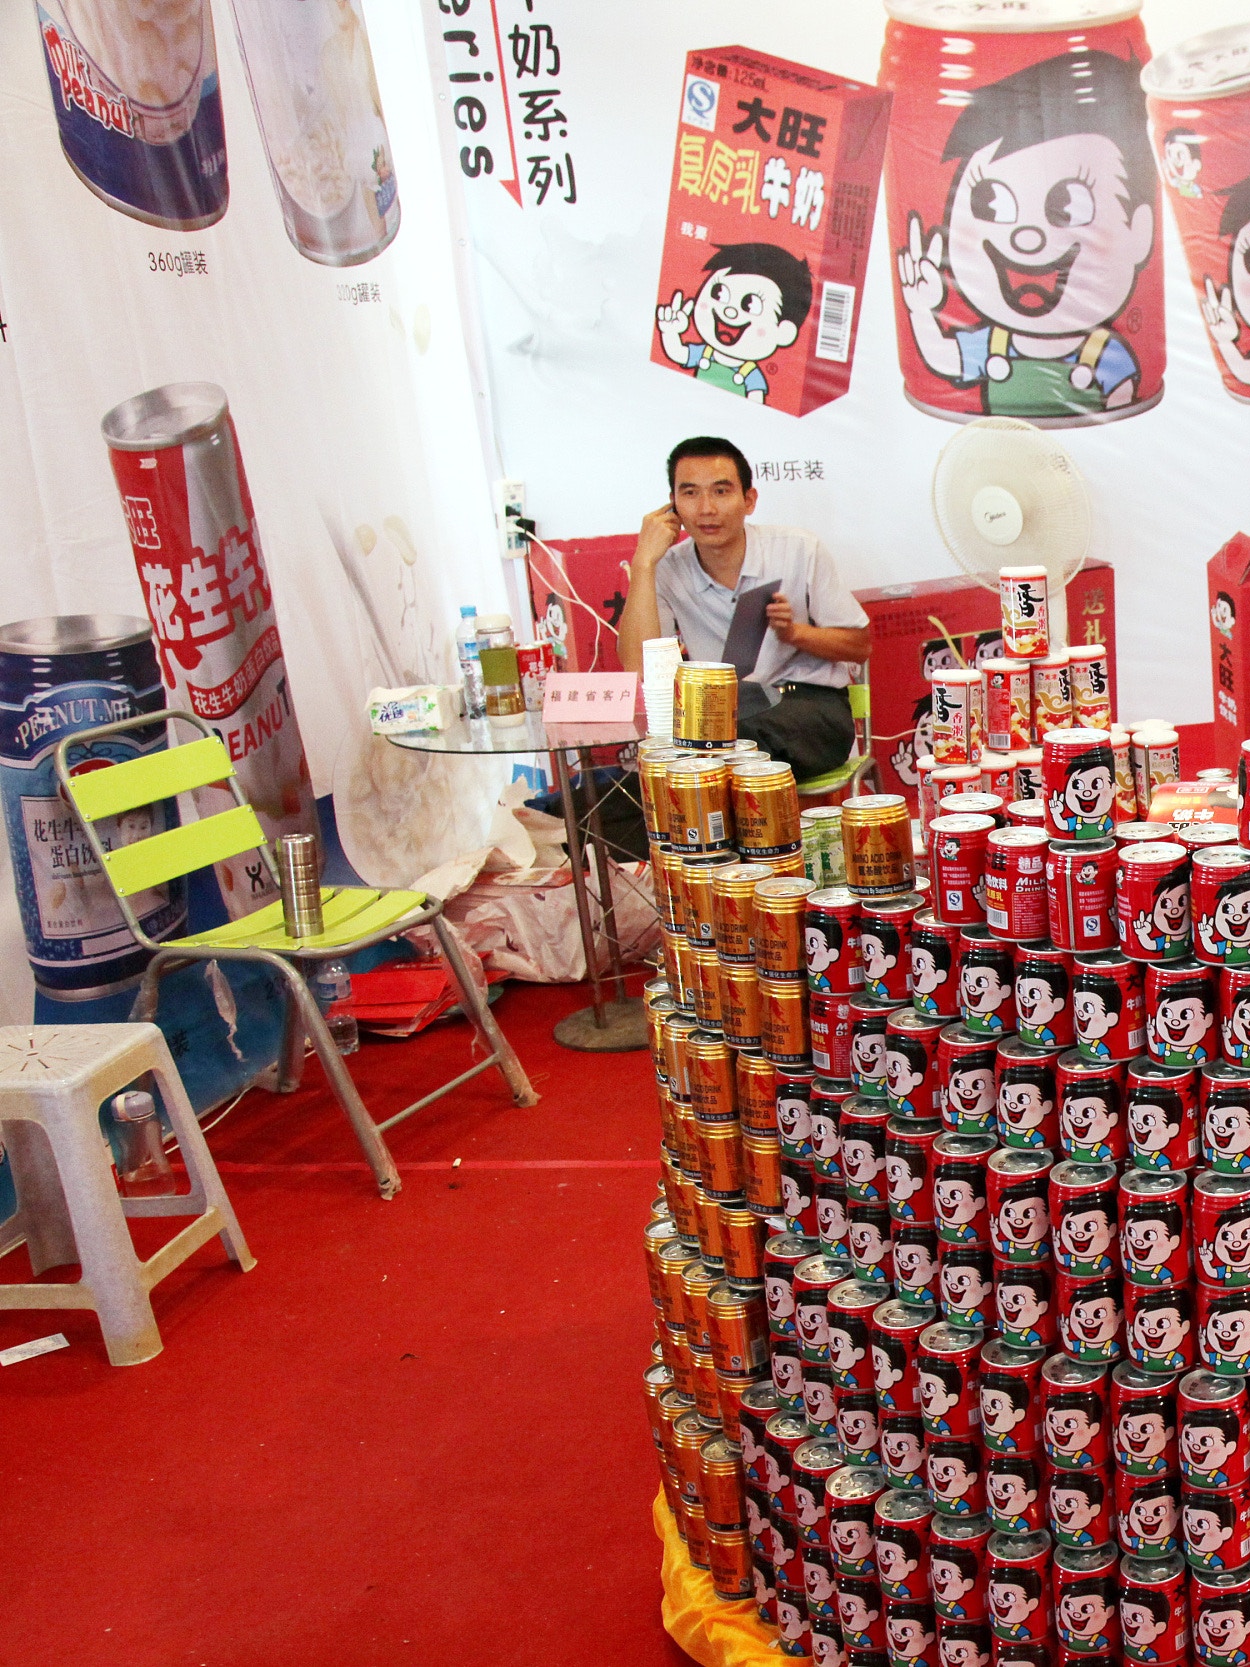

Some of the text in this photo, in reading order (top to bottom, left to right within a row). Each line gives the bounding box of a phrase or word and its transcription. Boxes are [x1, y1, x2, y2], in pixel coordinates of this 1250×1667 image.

[732, 97, 827, 158] 大旺
[761, 157, 825, 231] 牛奶
[148, 250, 209, 278] 360g罐装
[142, 517, 273, 641] 花生牛
[1219, 642, 1234, 694] 大旺
[550, 689, 632, 704] 福建省客户
[228, 677, 292, 762] EANUT
[870, 852, 884, 863] ACID
[1018, 855, 1044, 870] 精品
[1015, 876, 1046, 886] MILK
[731, 924, 749, 933] DRINK
[770, 940, 788, 949] DRINK
[769, 970, 799, 979] 强化生命力
